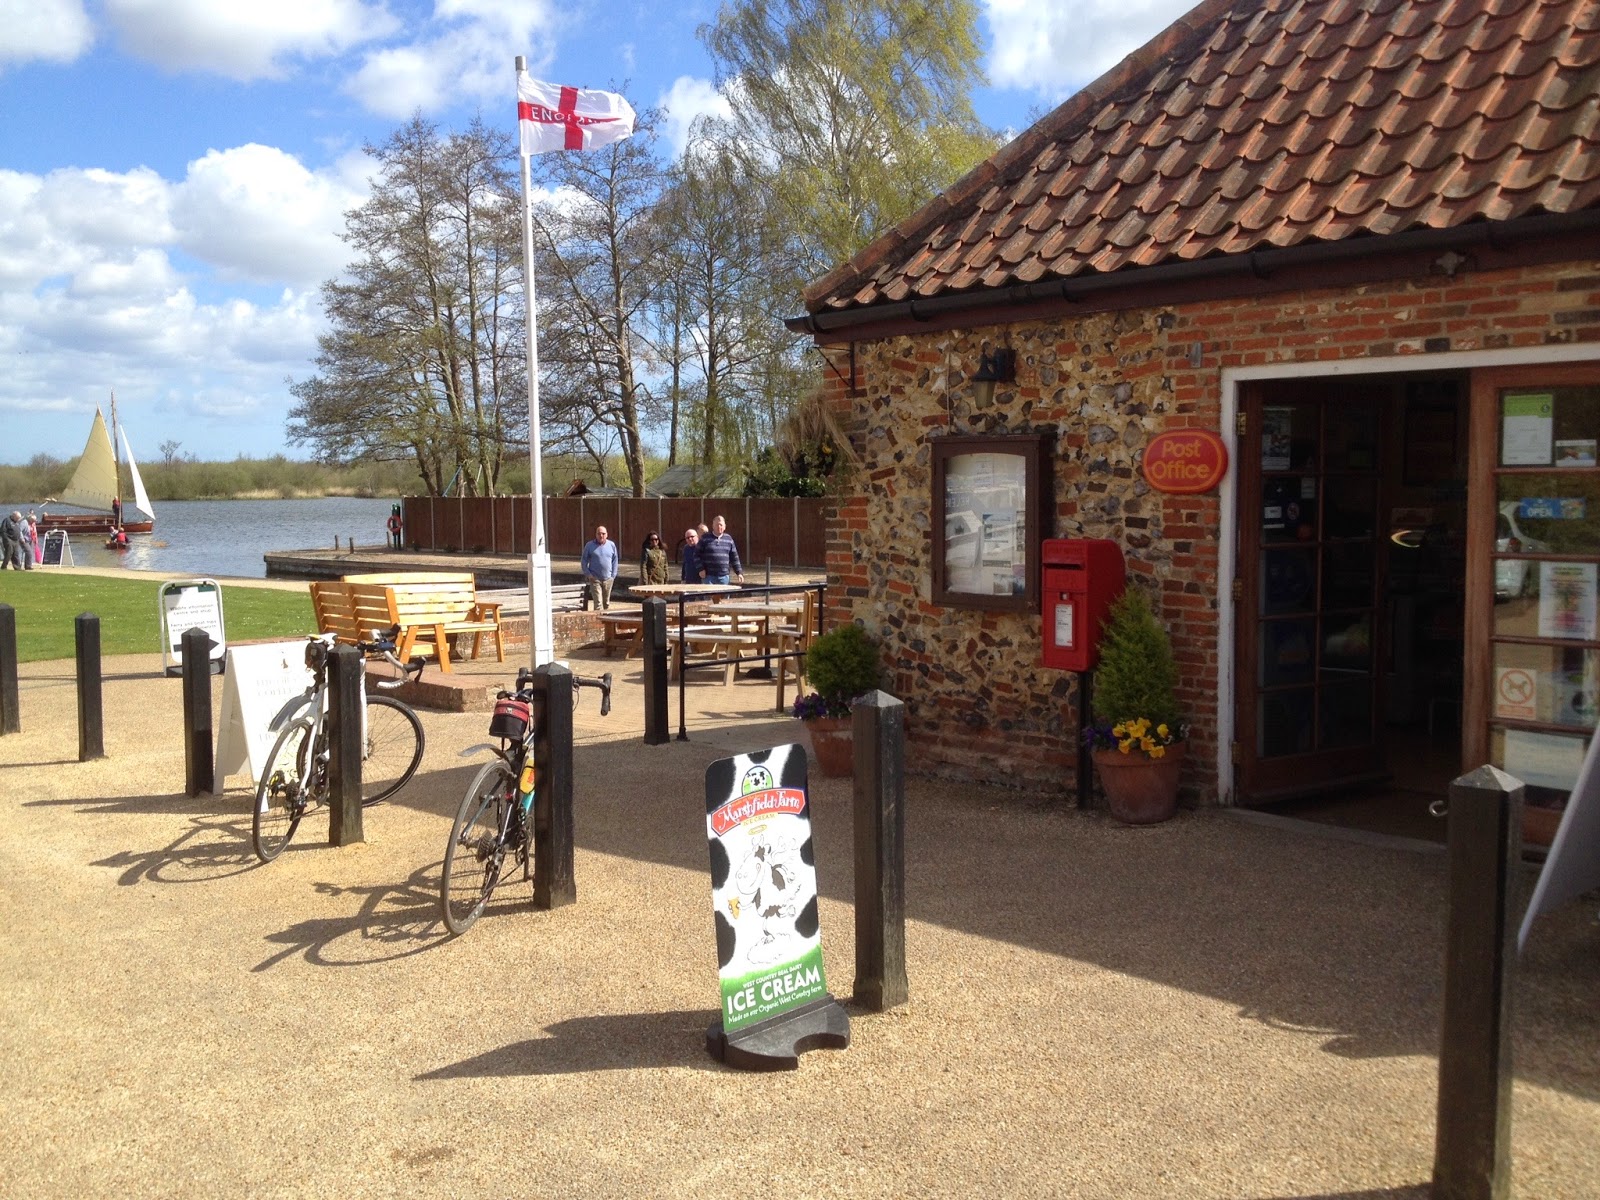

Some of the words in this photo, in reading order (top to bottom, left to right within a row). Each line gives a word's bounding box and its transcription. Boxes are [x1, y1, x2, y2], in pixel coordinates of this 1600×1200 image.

[1162, 440, 1202, 458] Post
[1152, 460, 1210, 479] Office
[717, 794, 775, 830] Marshfield
[774, 790, 800, 809] Farm
[743, 818, 754, 826] ICE
[754, 813, 775, 822] CREAM
[743, 980, 755, 988] WEST
[755, 973, 777, 984] COUNTRY
[777, 968, 789, 976] REAL
[788, 963, 802, 973] DAIRY
[727, 987, 756, 1014] ICE
[761, 965, 821, 1001] CREAM
[728, 1013, 743, 1024] Made
[758, 1000, 779, 1013] Organic
[778, 995, 792, 1005] West
[791, 989, 811, 1000] Country
